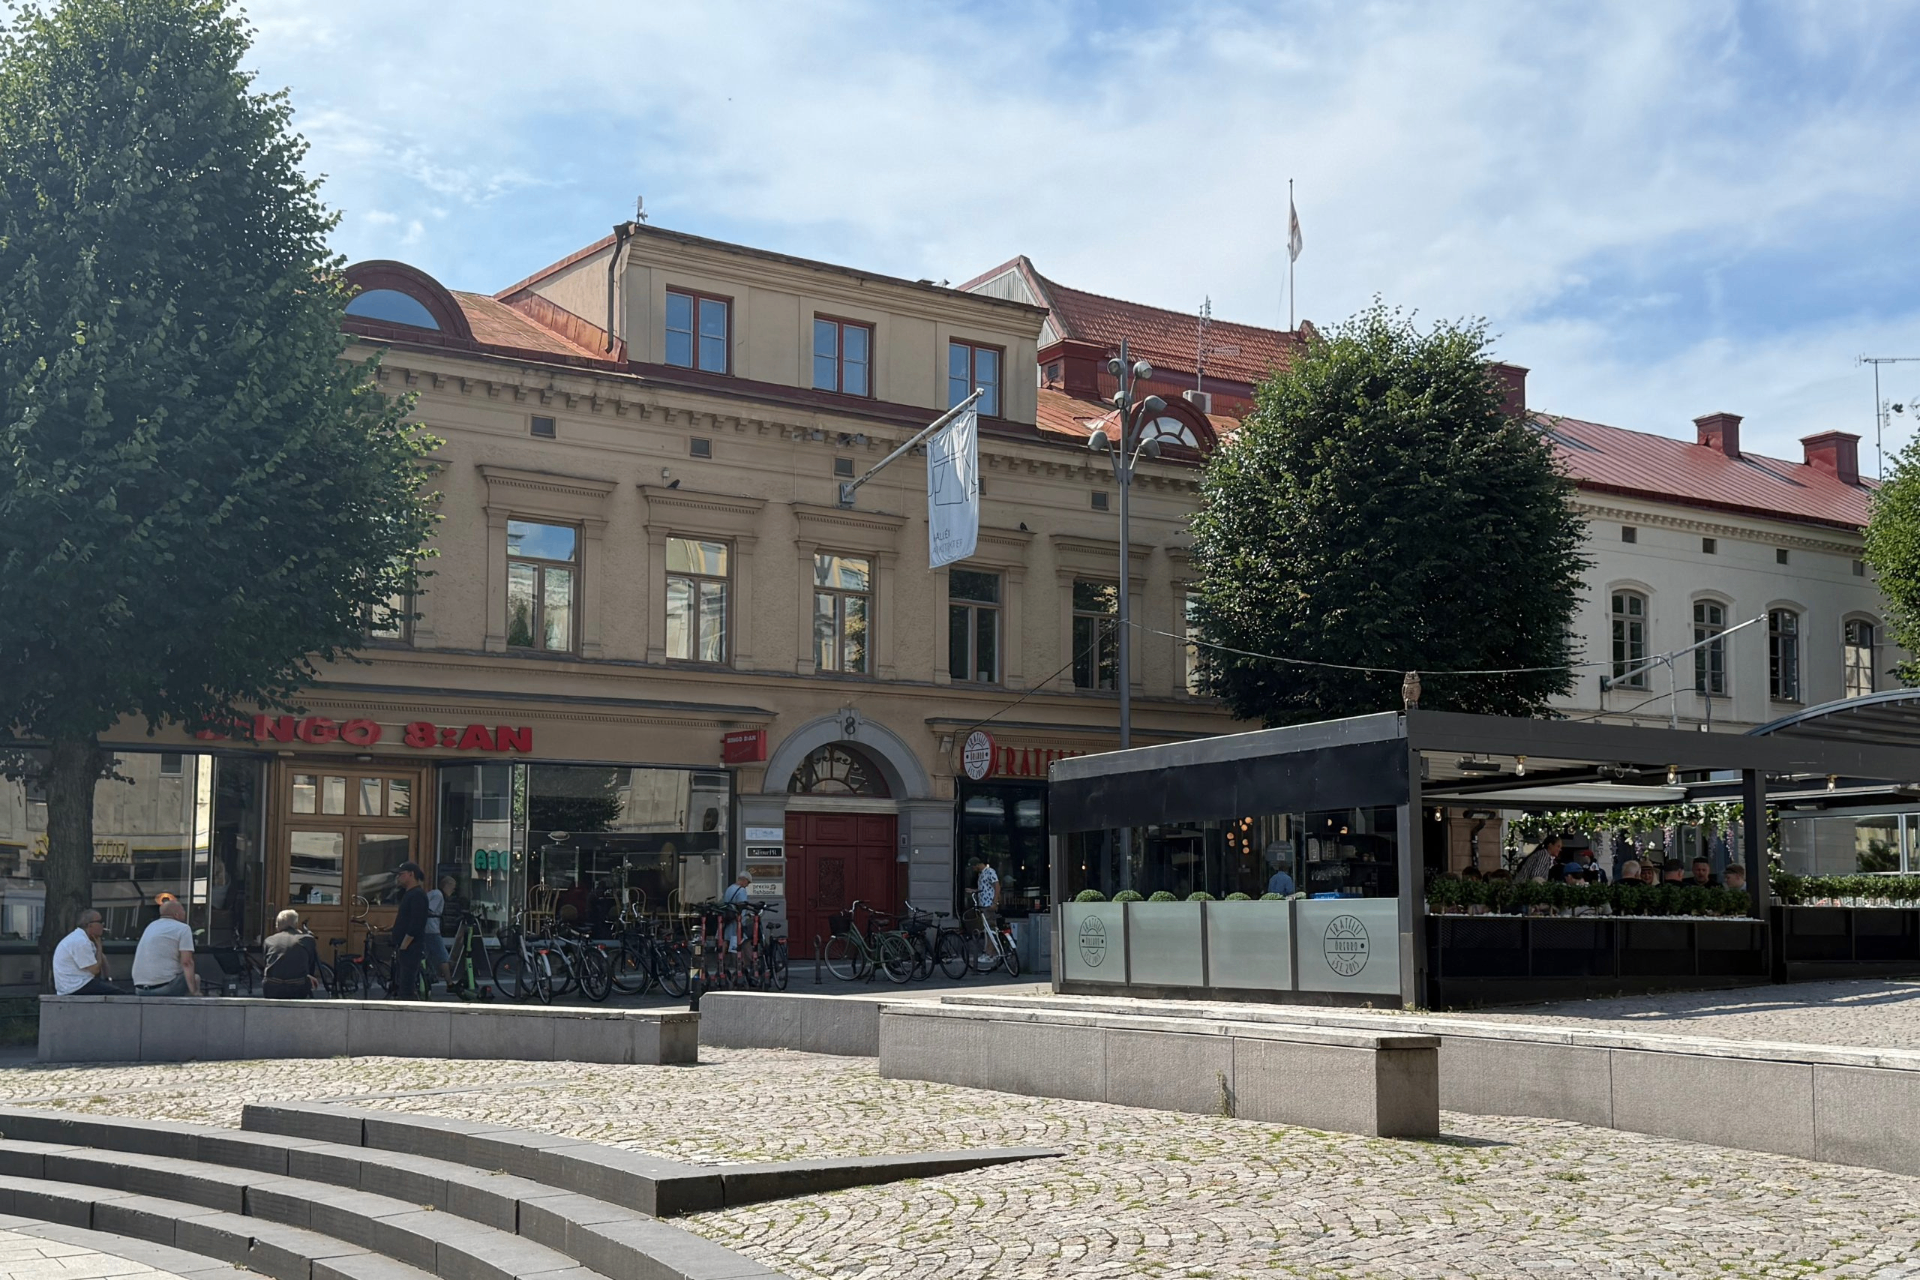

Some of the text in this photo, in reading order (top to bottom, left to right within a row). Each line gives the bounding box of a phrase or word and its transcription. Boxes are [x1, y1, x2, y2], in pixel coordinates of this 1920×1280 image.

[844, 716, 856, 735] 8
[1329, 917, 1363, 935] FRATELLI
[1334, 940, 1358, 951] ÖREBRO
